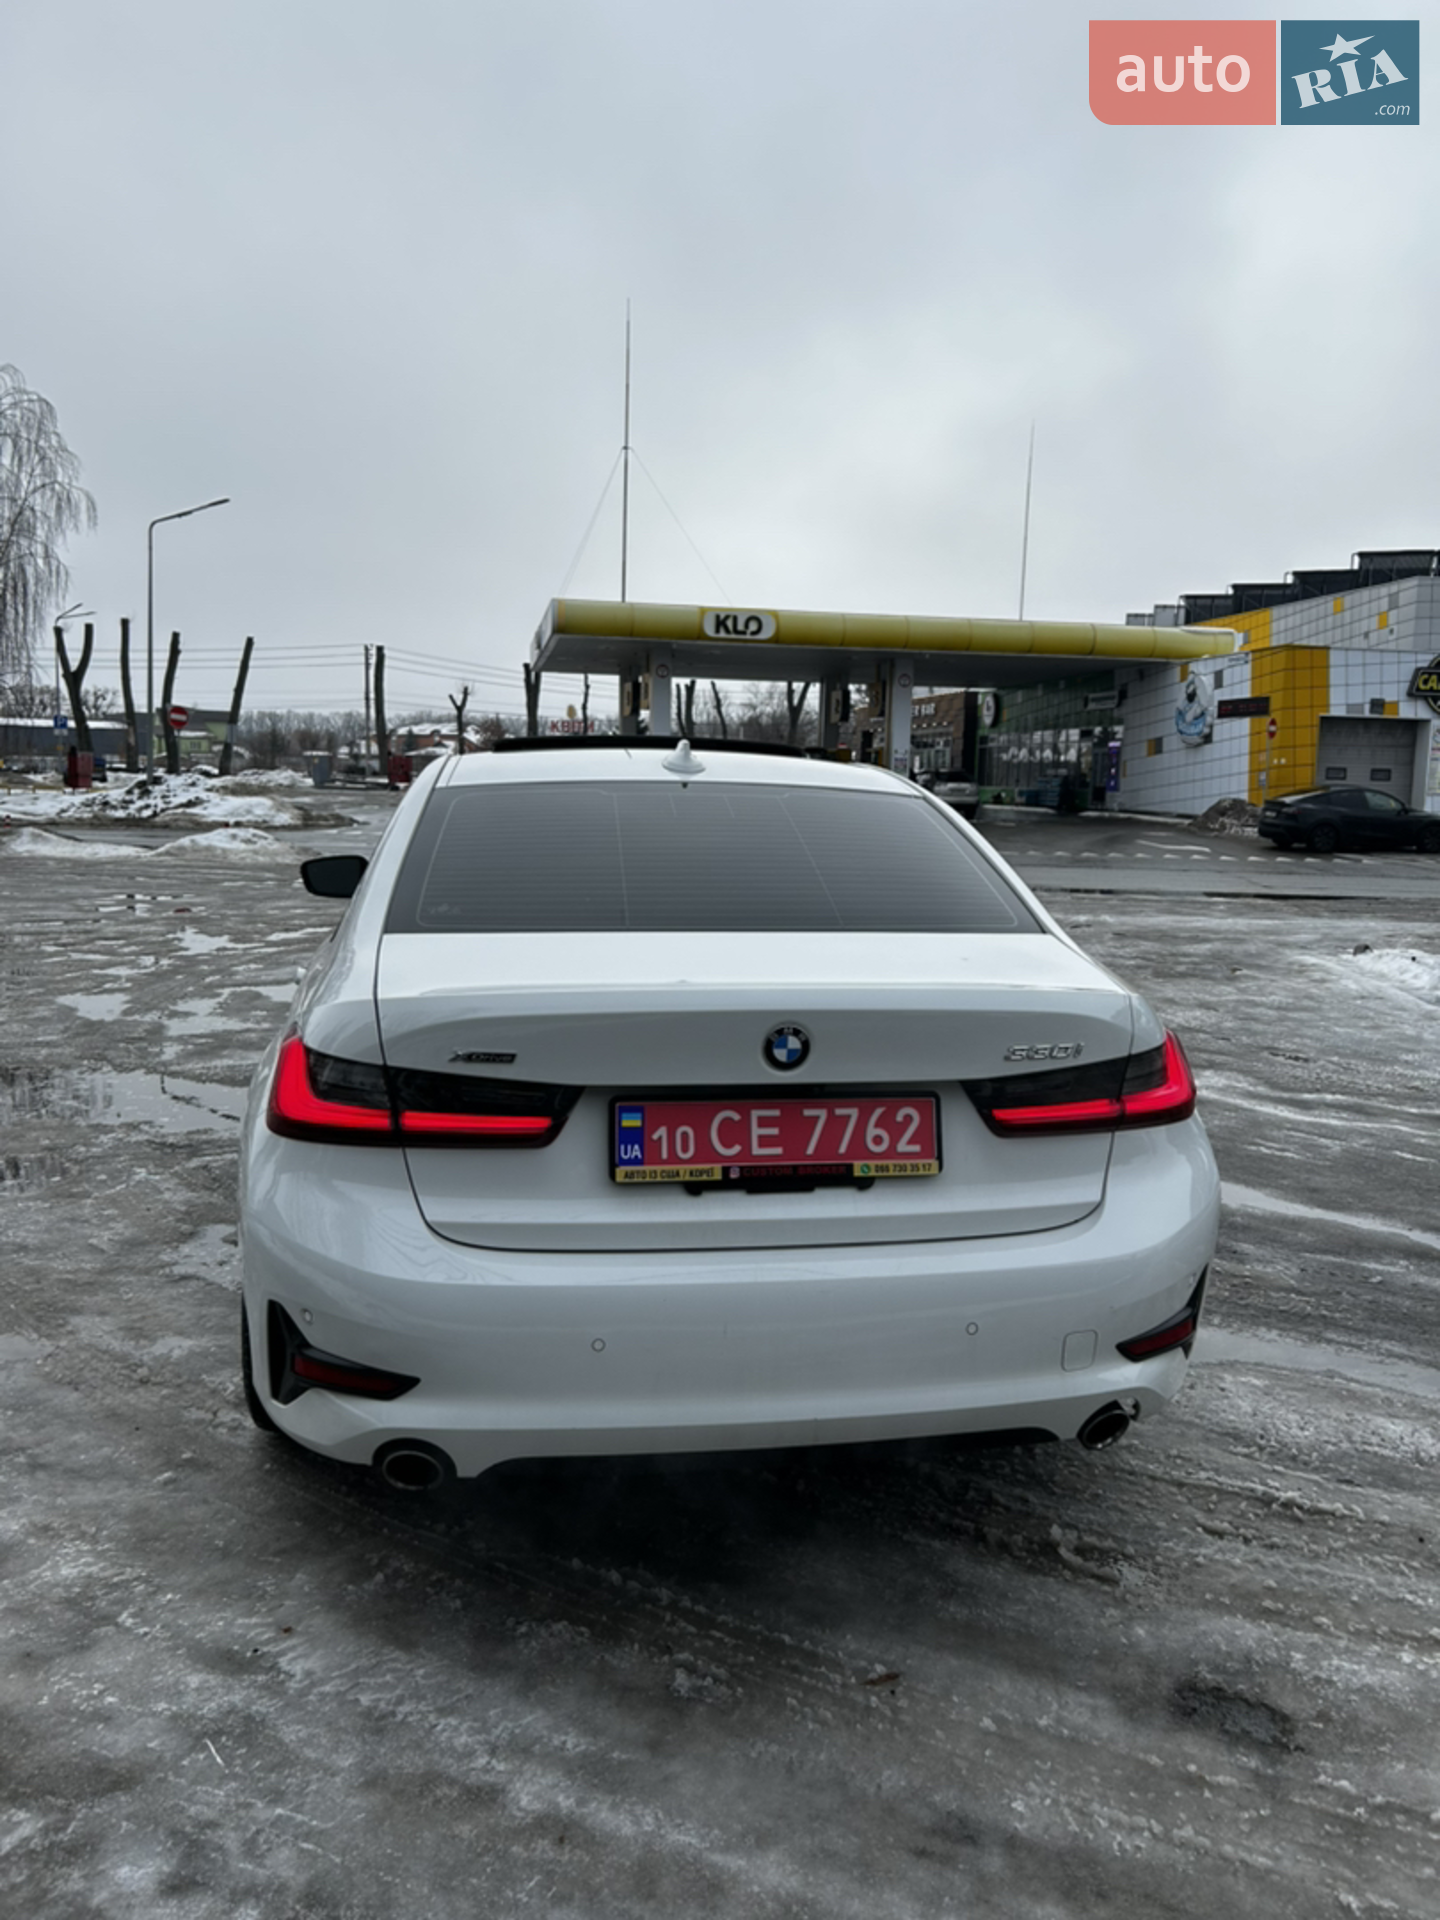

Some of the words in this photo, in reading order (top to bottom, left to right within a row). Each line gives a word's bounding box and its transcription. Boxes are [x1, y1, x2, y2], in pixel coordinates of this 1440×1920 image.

[714, 613, 763, 637] KLO
[651, 1125, 695, 1160] 10
[710, 1109, 784, 1157] CE
[803, 1106, 922, 1156] 7762
[620, 1144, 642, 1160] UA
